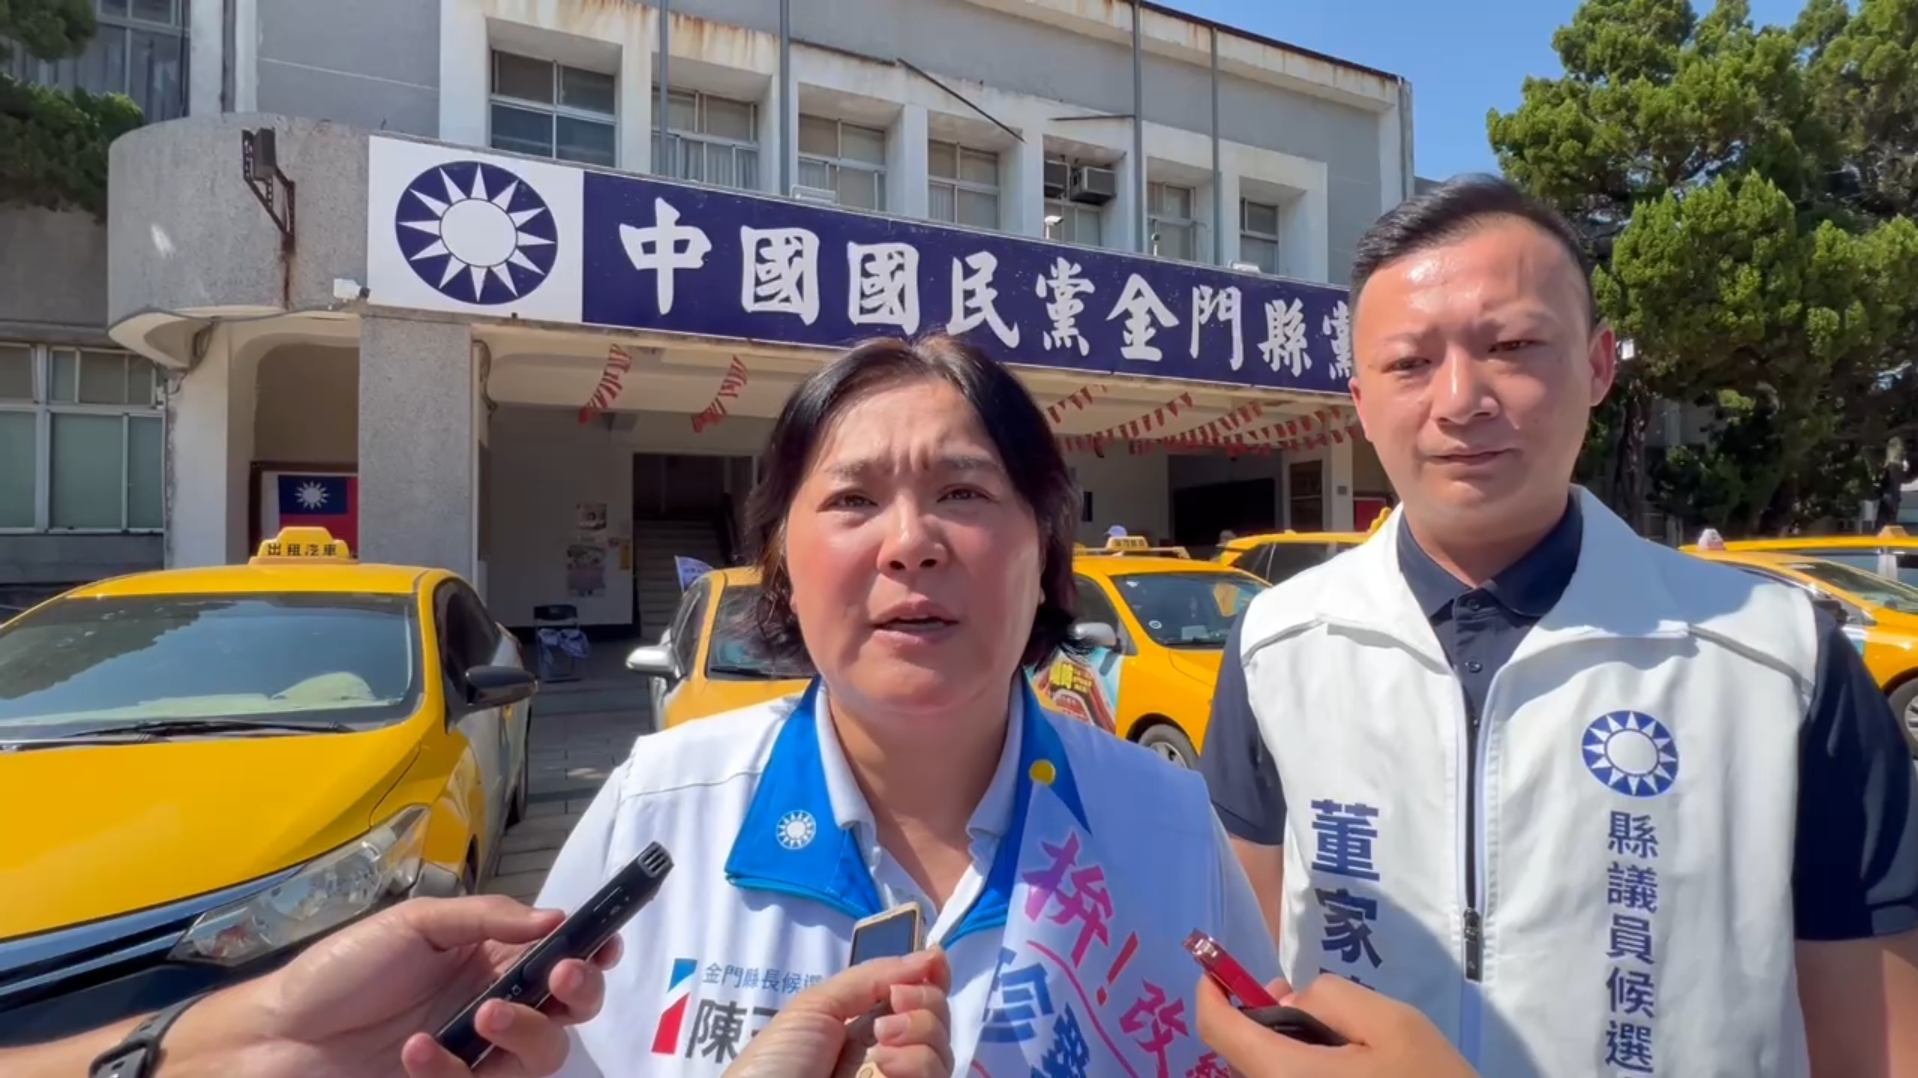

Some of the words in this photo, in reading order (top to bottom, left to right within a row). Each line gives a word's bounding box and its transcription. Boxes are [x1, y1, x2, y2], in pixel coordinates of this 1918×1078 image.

[268, 542, 337, 556] 出租汽車
[1311, 799, 1383, 991] 董家
[1604, 810, 1659, 1078] 縣議員候選
